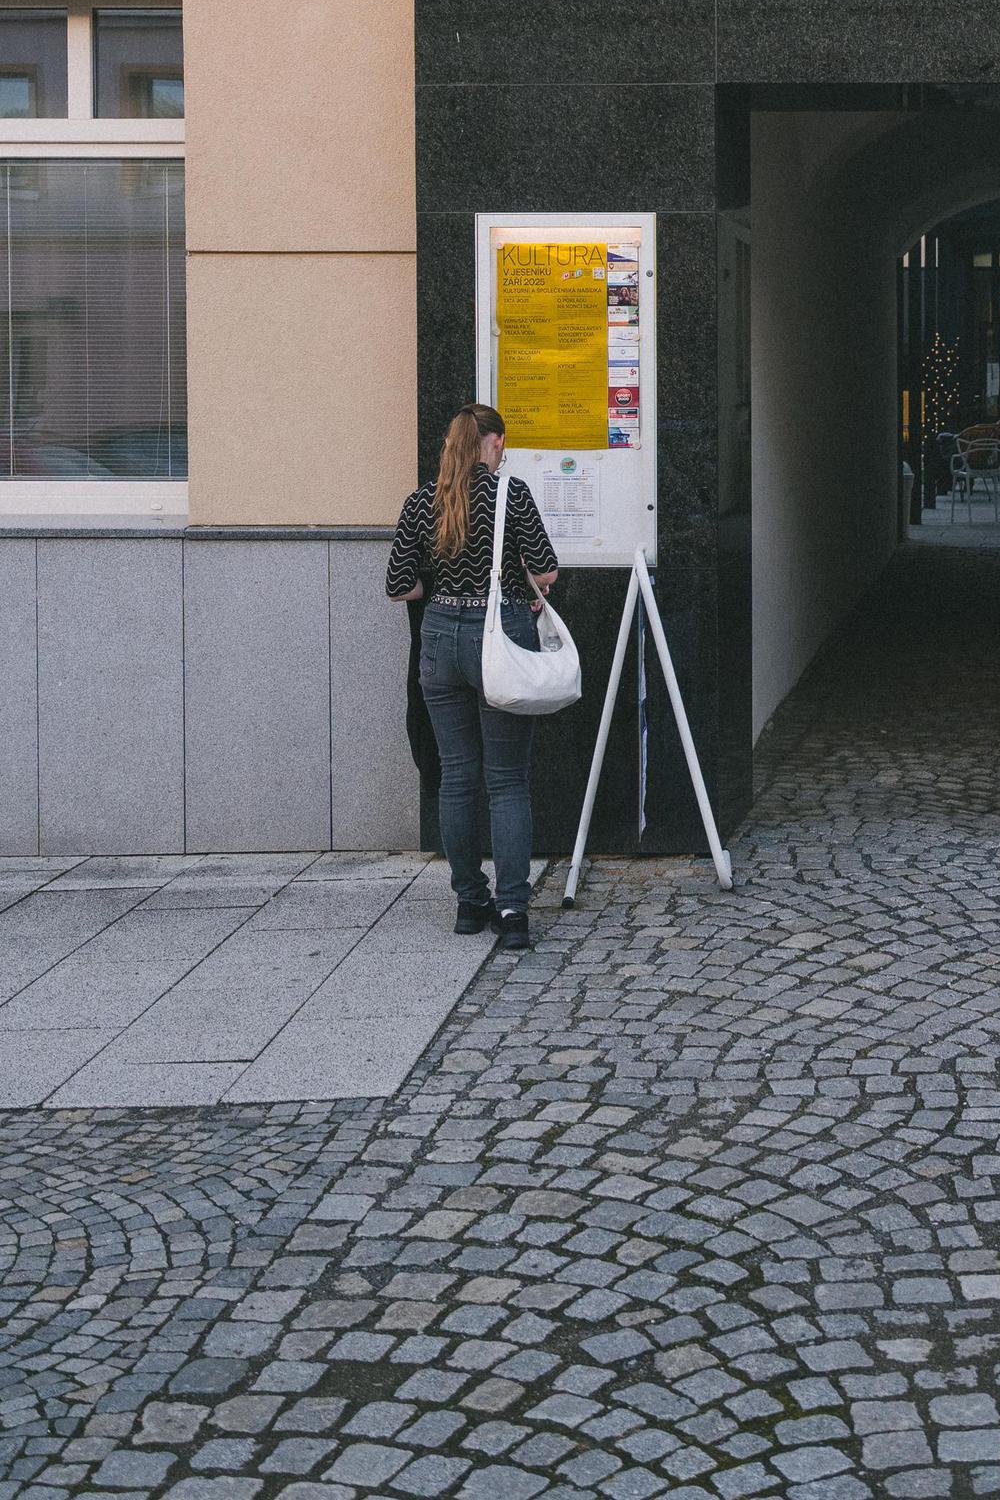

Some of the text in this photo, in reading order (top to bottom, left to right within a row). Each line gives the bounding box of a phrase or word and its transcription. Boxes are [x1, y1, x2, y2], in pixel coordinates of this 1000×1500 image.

[502, 245, 604, 266] KULTURA
[503, 268, 510, 276] V
[524, 278, 546, 286] 2025
